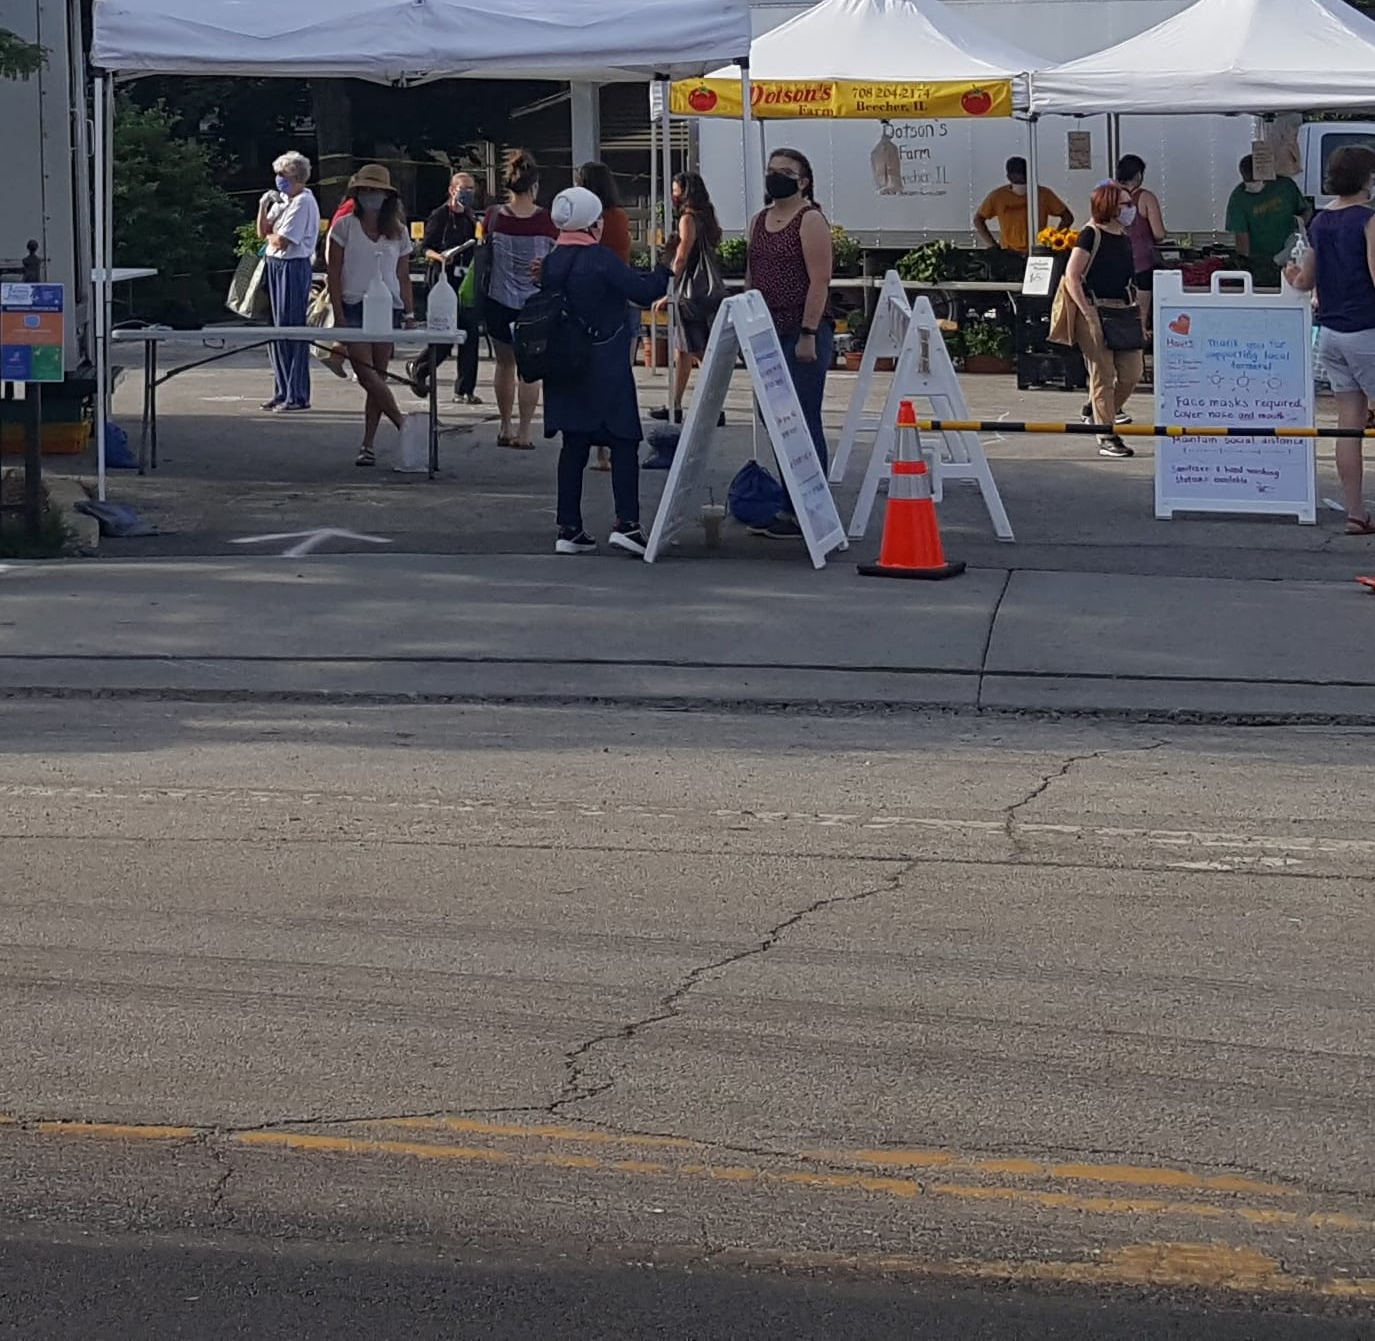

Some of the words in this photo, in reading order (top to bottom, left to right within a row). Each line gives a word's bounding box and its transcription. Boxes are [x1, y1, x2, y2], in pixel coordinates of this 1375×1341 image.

[750, 85, 832, 107] Dotson's
[852, 87, 873, 99] 708
[883, 119, 948, 139] Dotson's
[899, 145, 931, 160] Farm
[1176, 396, 1205, 408] Face
[1209, 397, 1249, 408] masks
[1239, 411, 1255, 419] and
